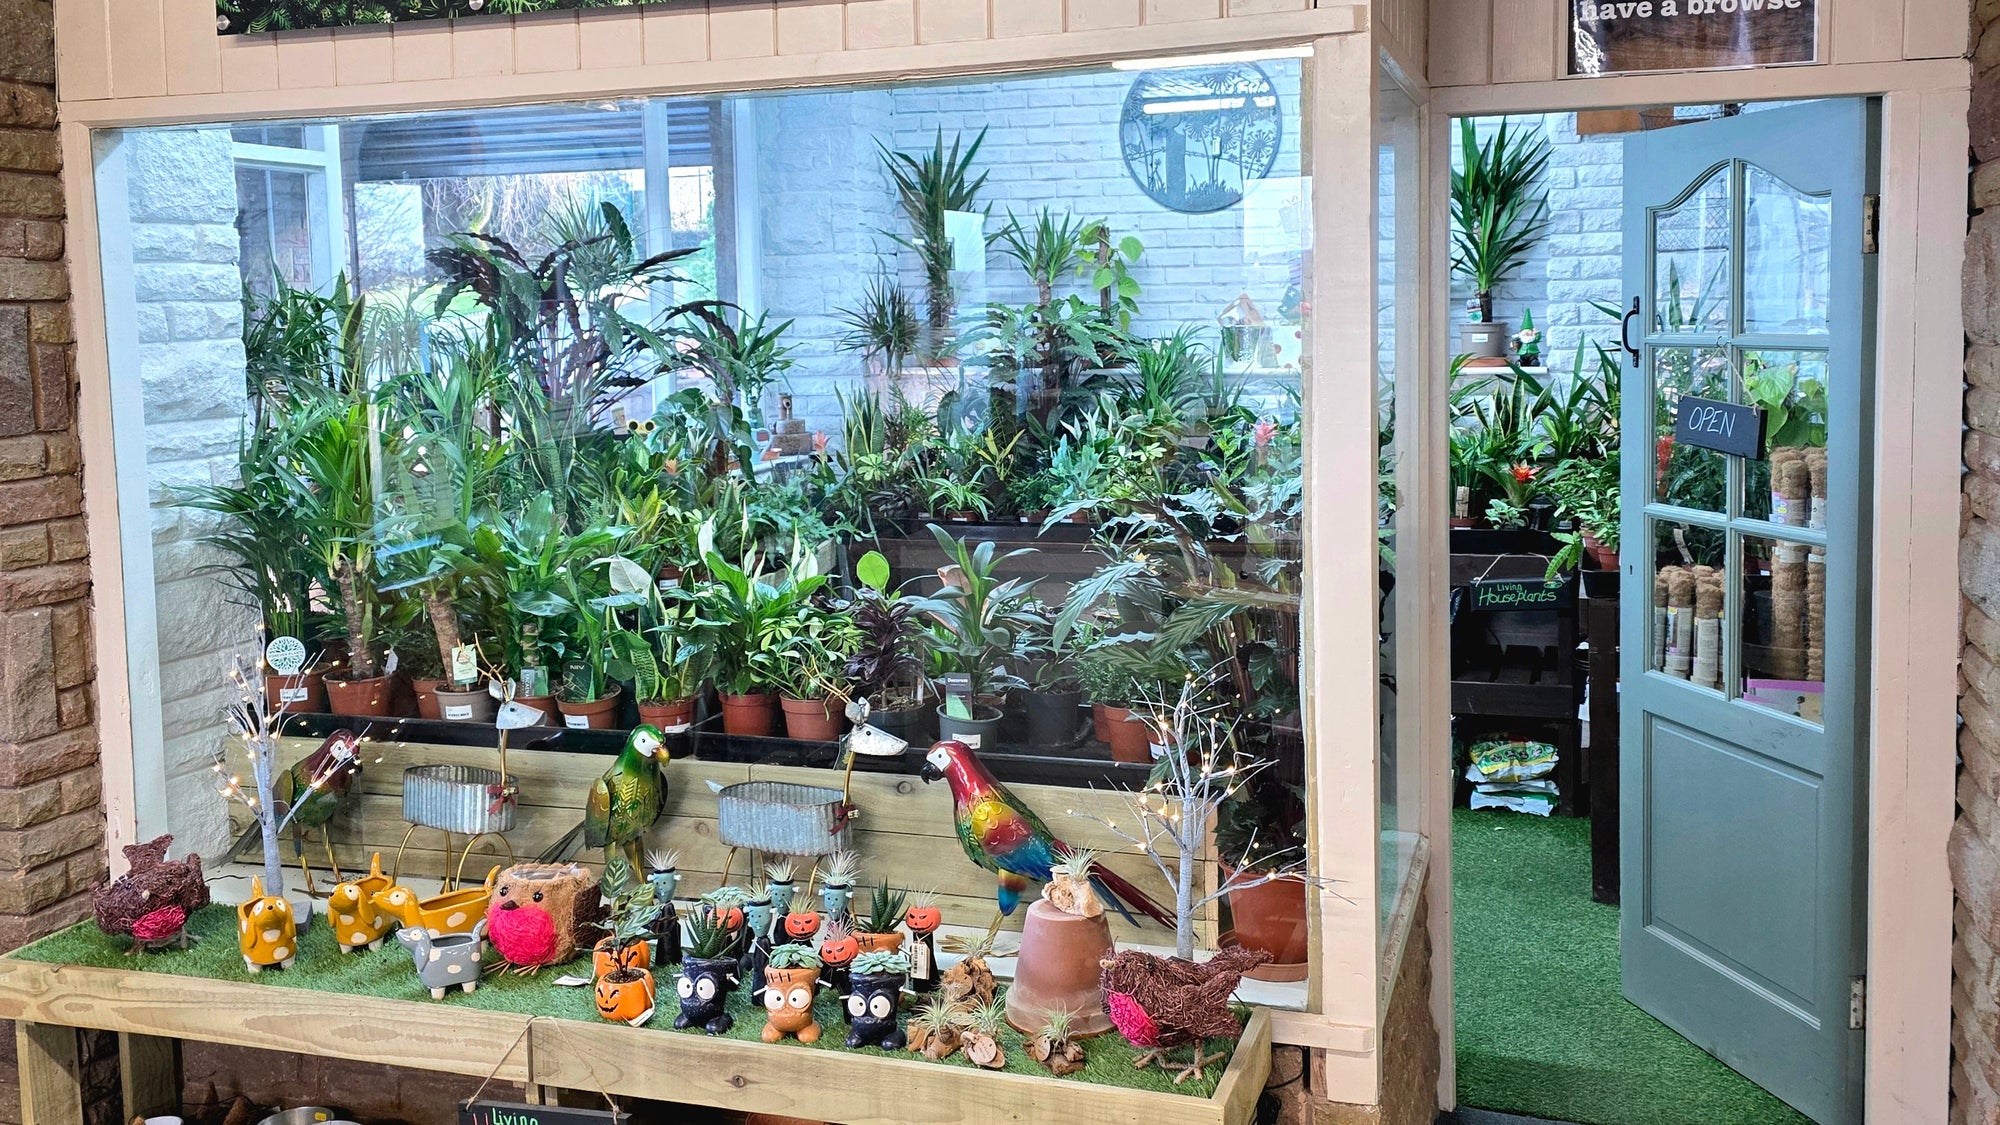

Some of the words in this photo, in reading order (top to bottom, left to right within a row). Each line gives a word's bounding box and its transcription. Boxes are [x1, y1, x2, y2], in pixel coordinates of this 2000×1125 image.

[1579, 0, 1653, 22] have
[1660, 0, 1678, 17] a
[1687, 0, 1802, 15] browse
[1688, 406, 1736, 438] OPEN
